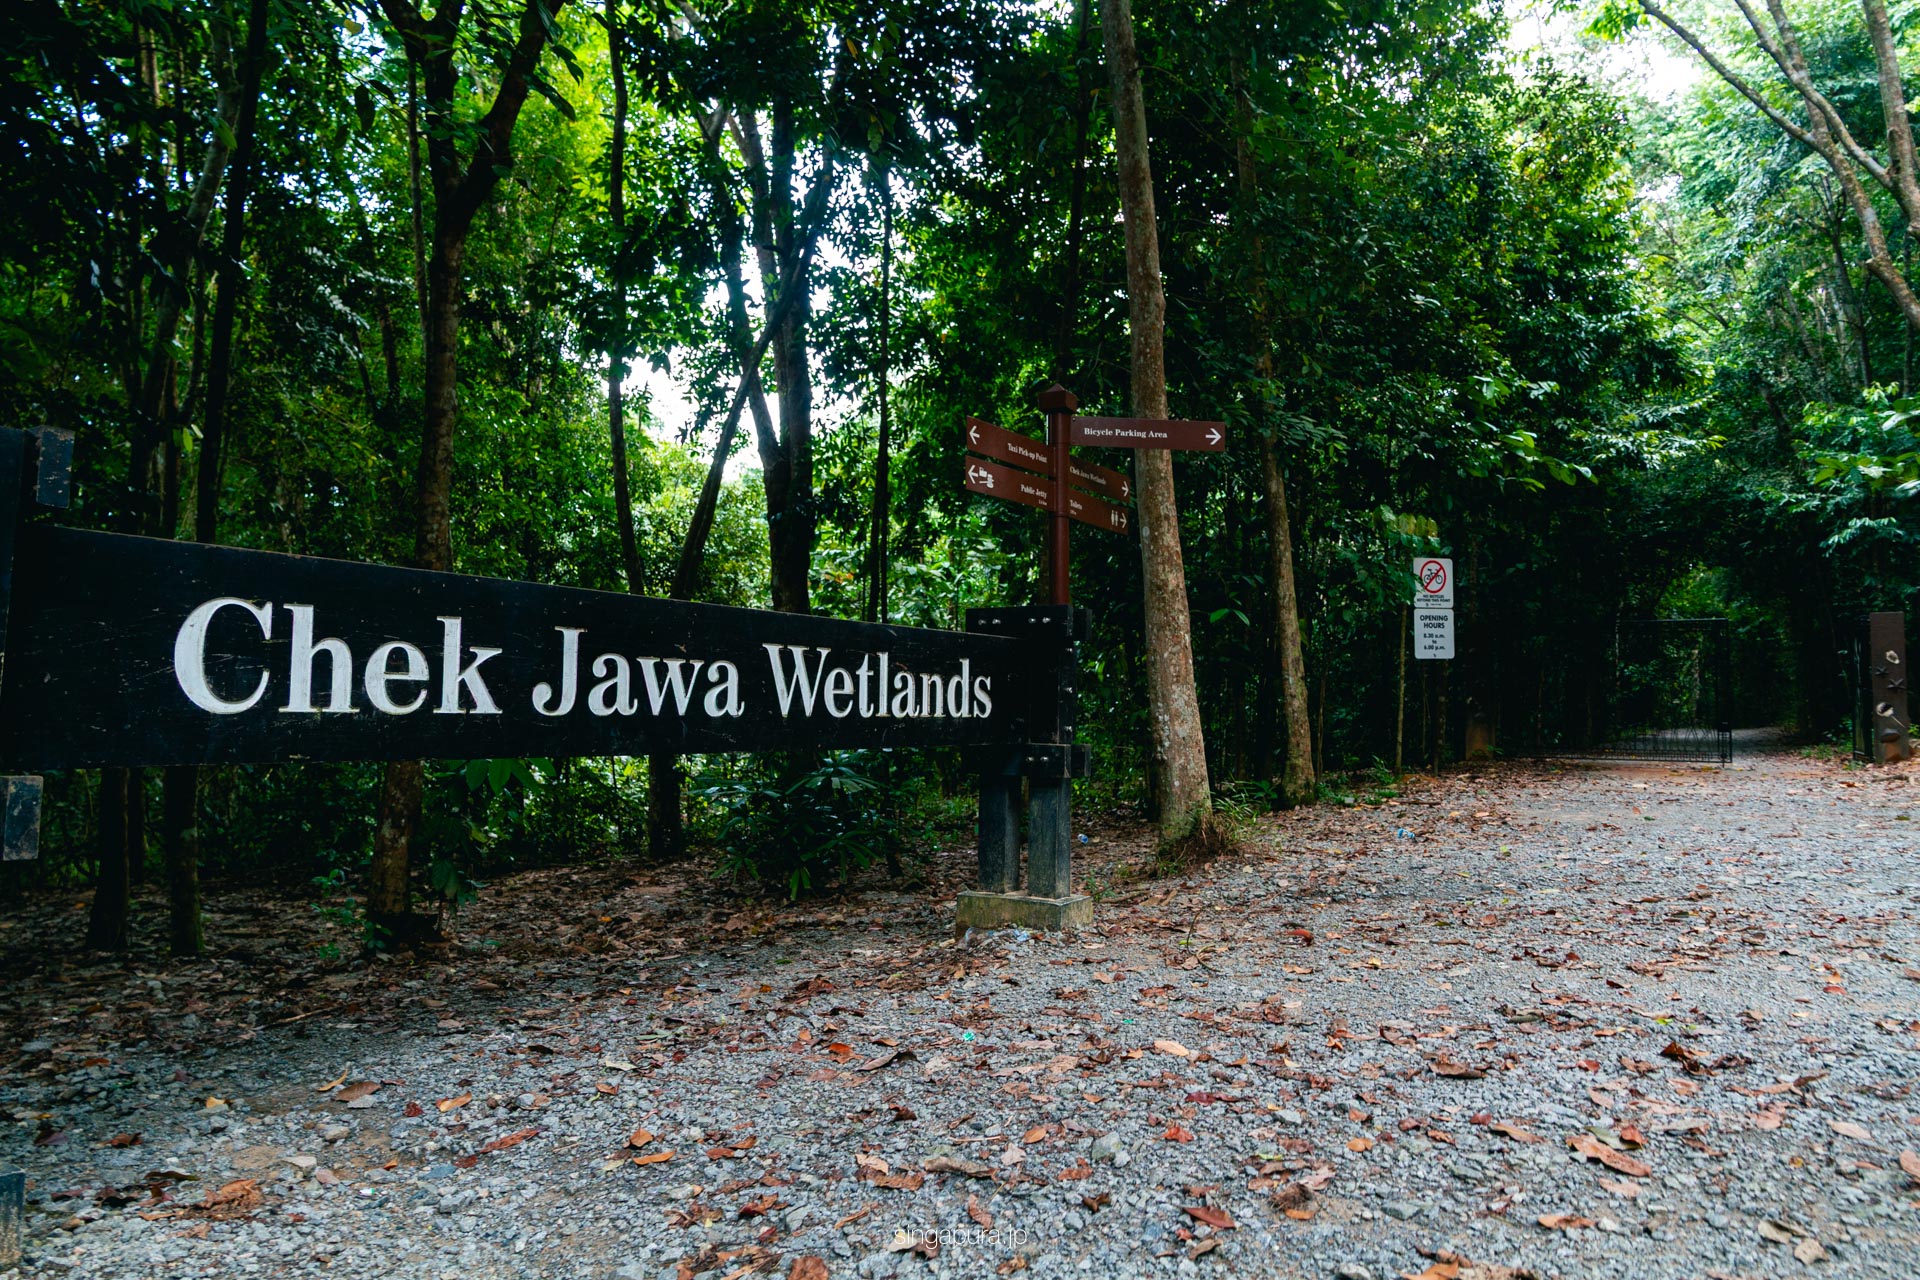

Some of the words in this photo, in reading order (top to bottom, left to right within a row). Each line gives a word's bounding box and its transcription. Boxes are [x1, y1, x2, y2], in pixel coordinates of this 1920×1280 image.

[1084, 427, 1113, 437] Bicycle
[1115, 428, 1146, 438] Parking
[1148, 430, 1168, 438] Area
[1020, 484, 1036, 495] Public
[1036, 488, 1047, 499] Jetty
[174, 597, 503, 715] Chek
[532, 626, 745, 718] Jawa
[762, 643, 993, 718] Wetlands
